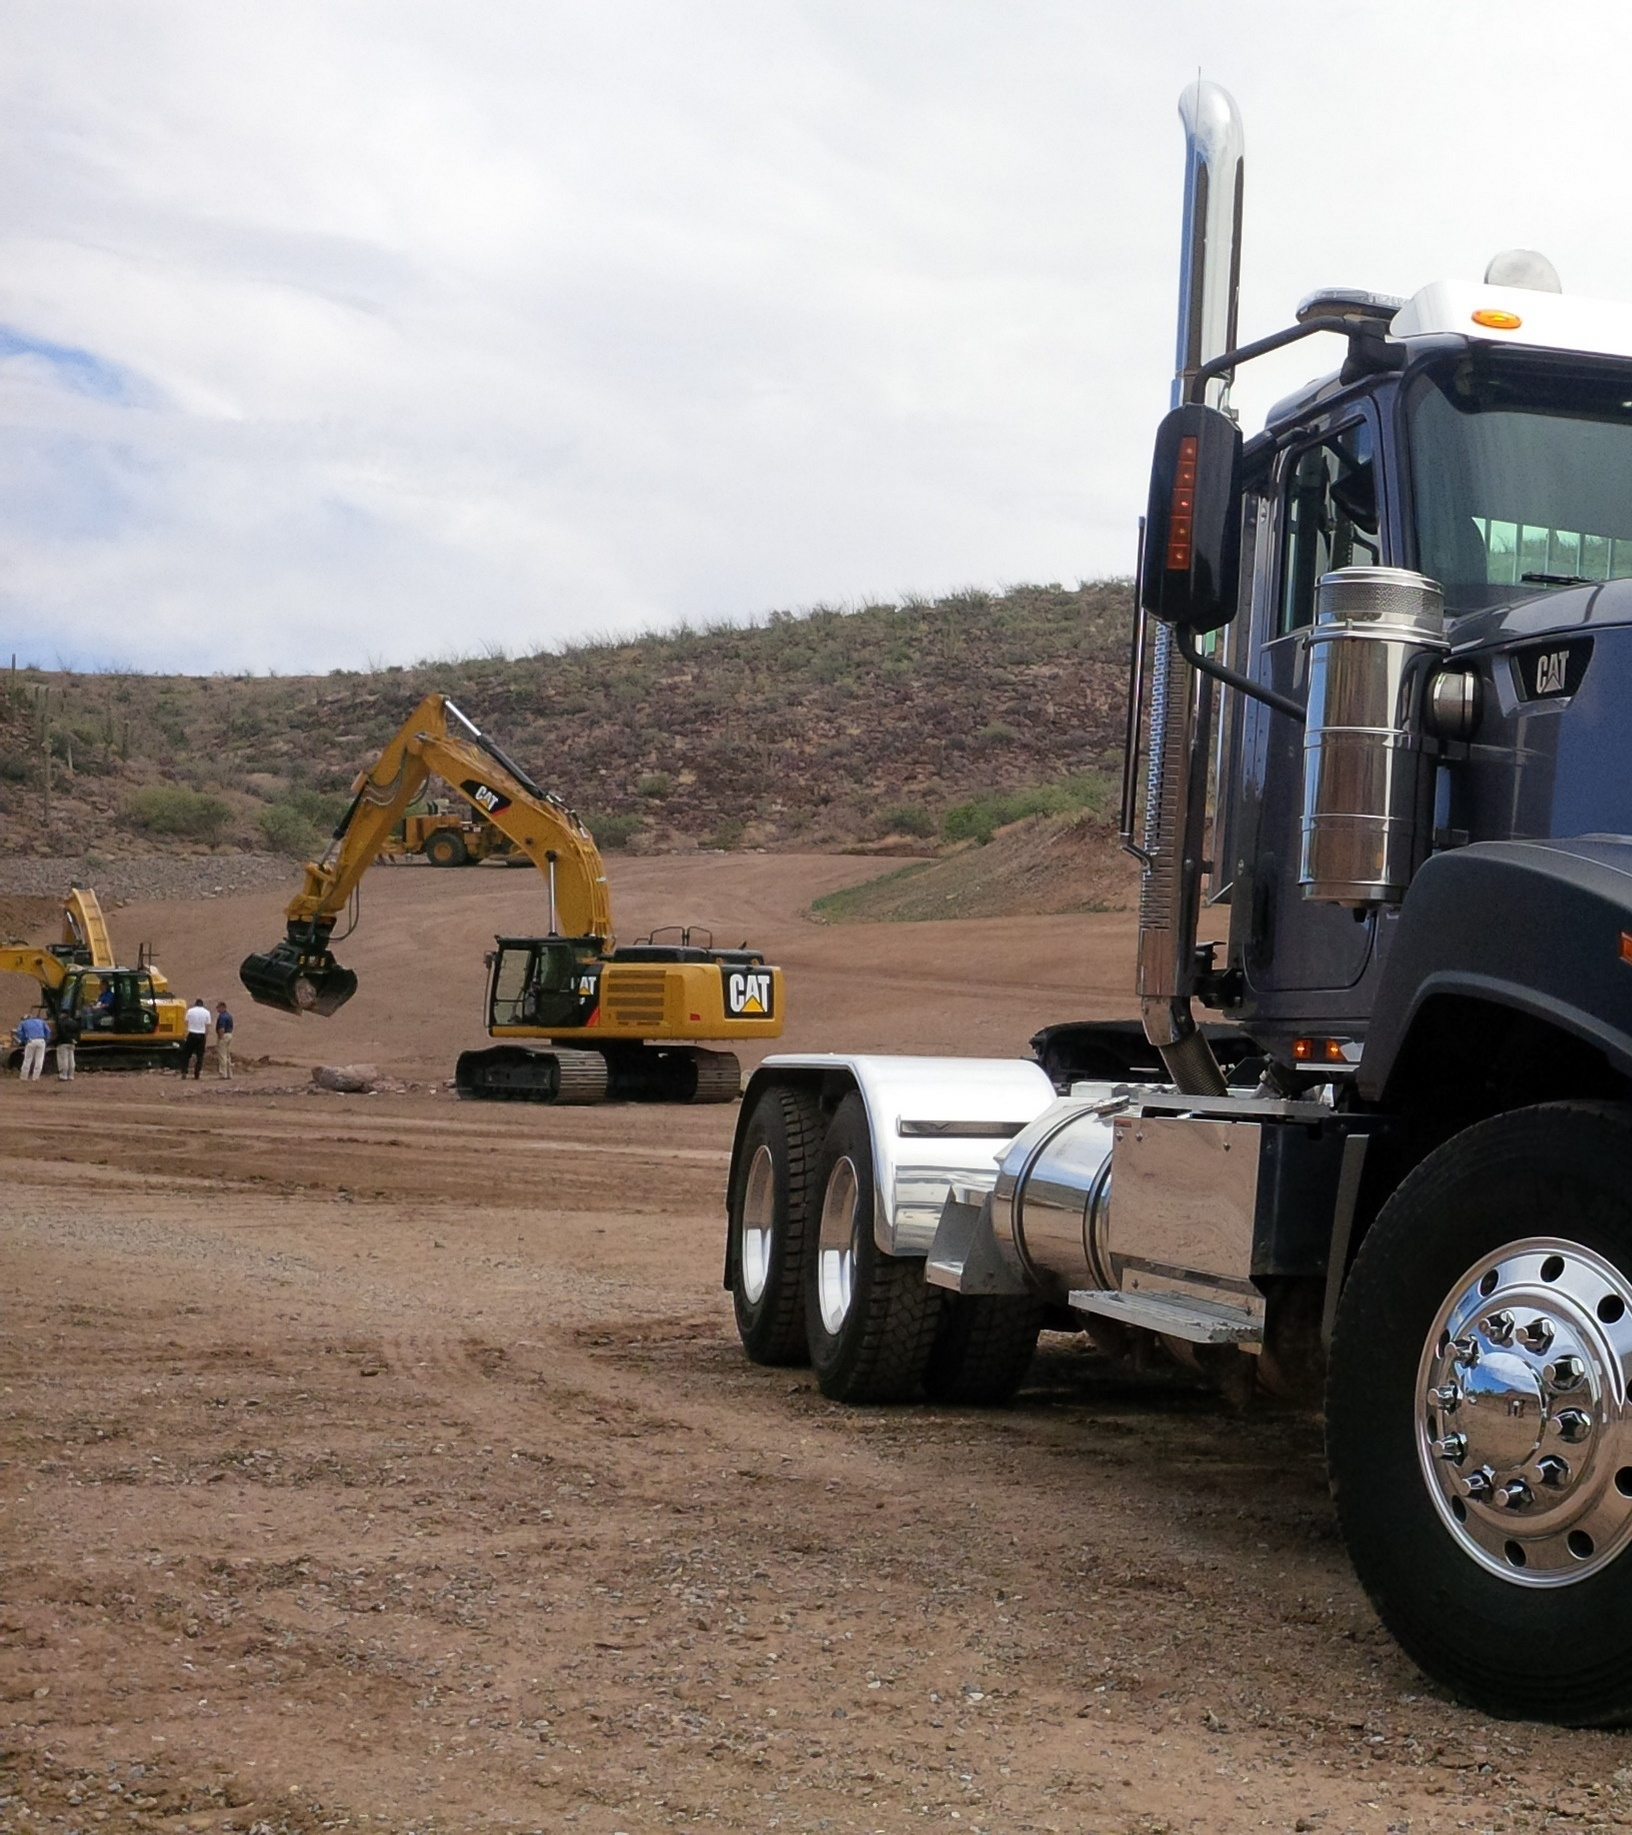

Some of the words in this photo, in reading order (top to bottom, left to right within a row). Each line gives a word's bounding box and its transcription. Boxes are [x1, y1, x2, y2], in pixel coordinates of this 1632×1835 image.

[1536, 650, 1570, 694] CAT
[475, 785, 499, 811] CAT
[730, 973, 770, 1013] CAT
